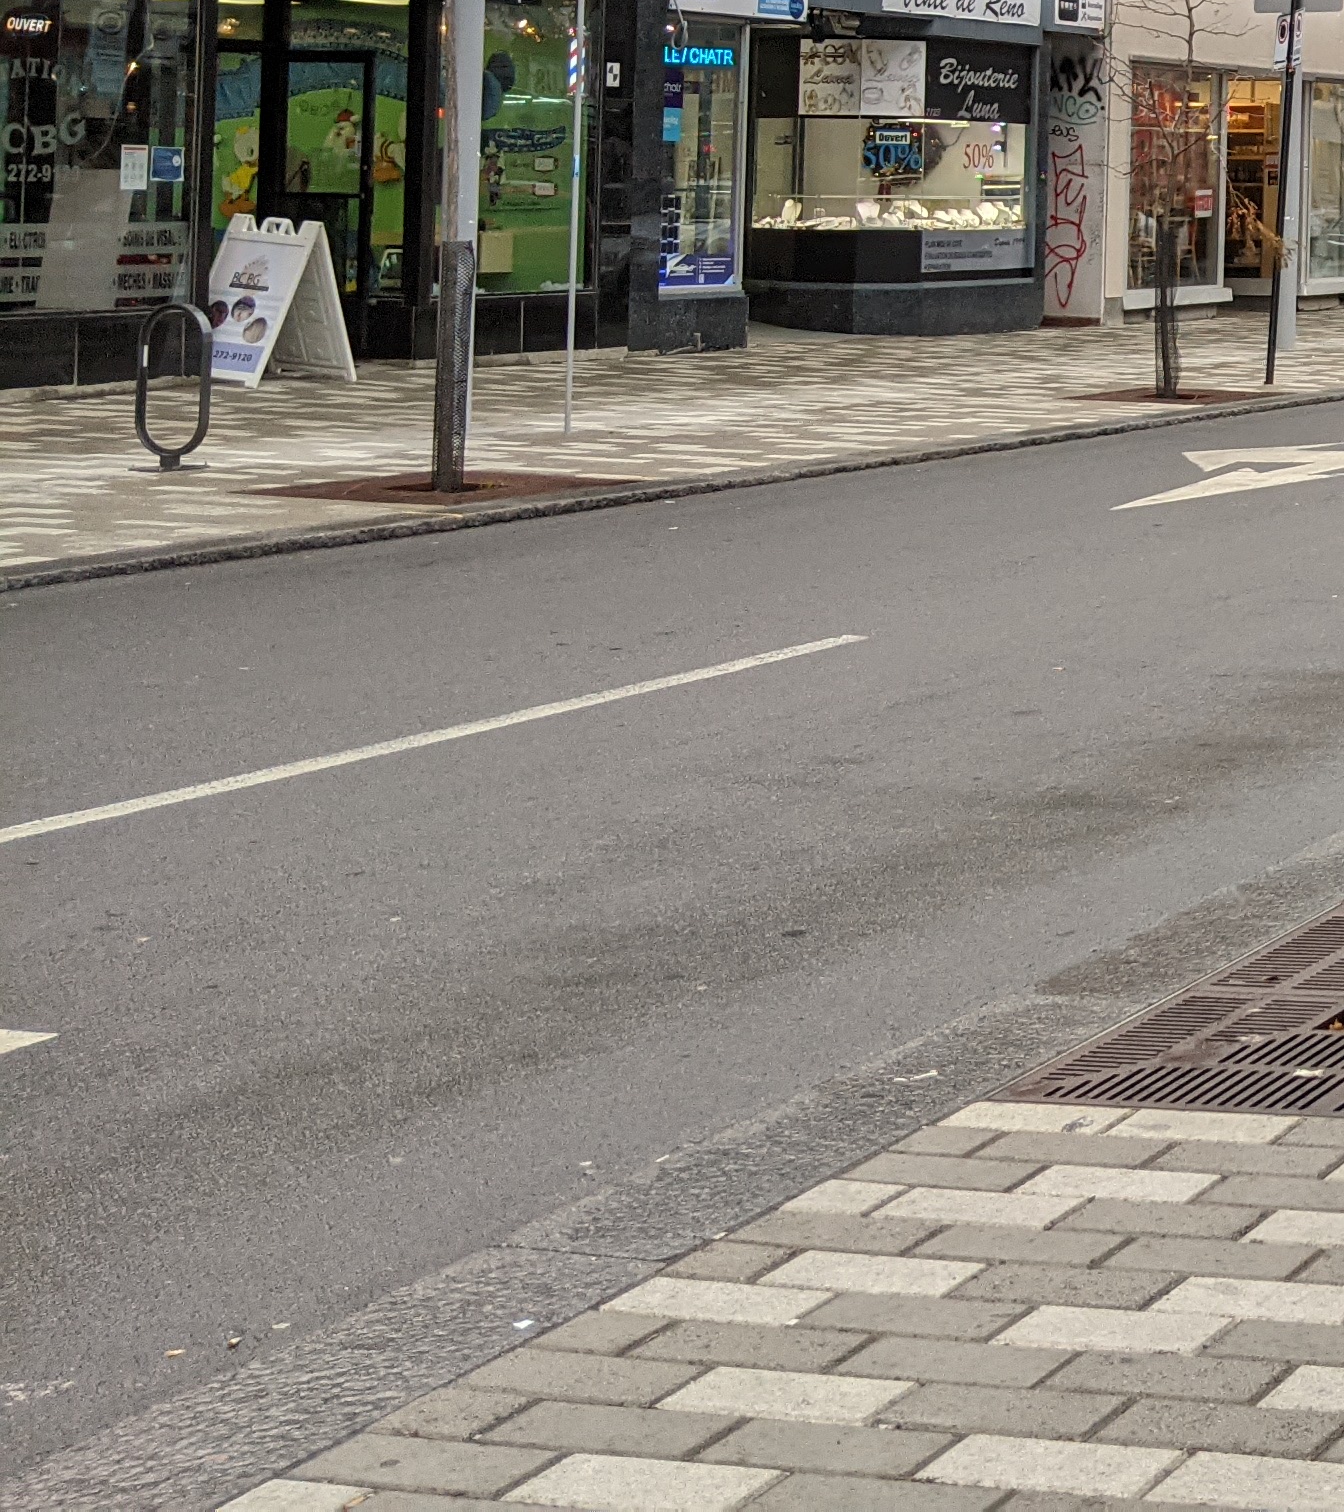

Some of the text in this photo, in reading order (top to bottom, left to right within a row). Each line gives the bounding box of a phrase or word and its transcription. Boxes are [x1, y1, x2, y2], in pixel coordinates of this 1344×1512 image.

[6, 16, 52, 33] OUVERT
[939, 57, 1019, 93] Bijouterie
[956, 90, 1000, 119] Luna
[962, 143, 994, 169] 50%
